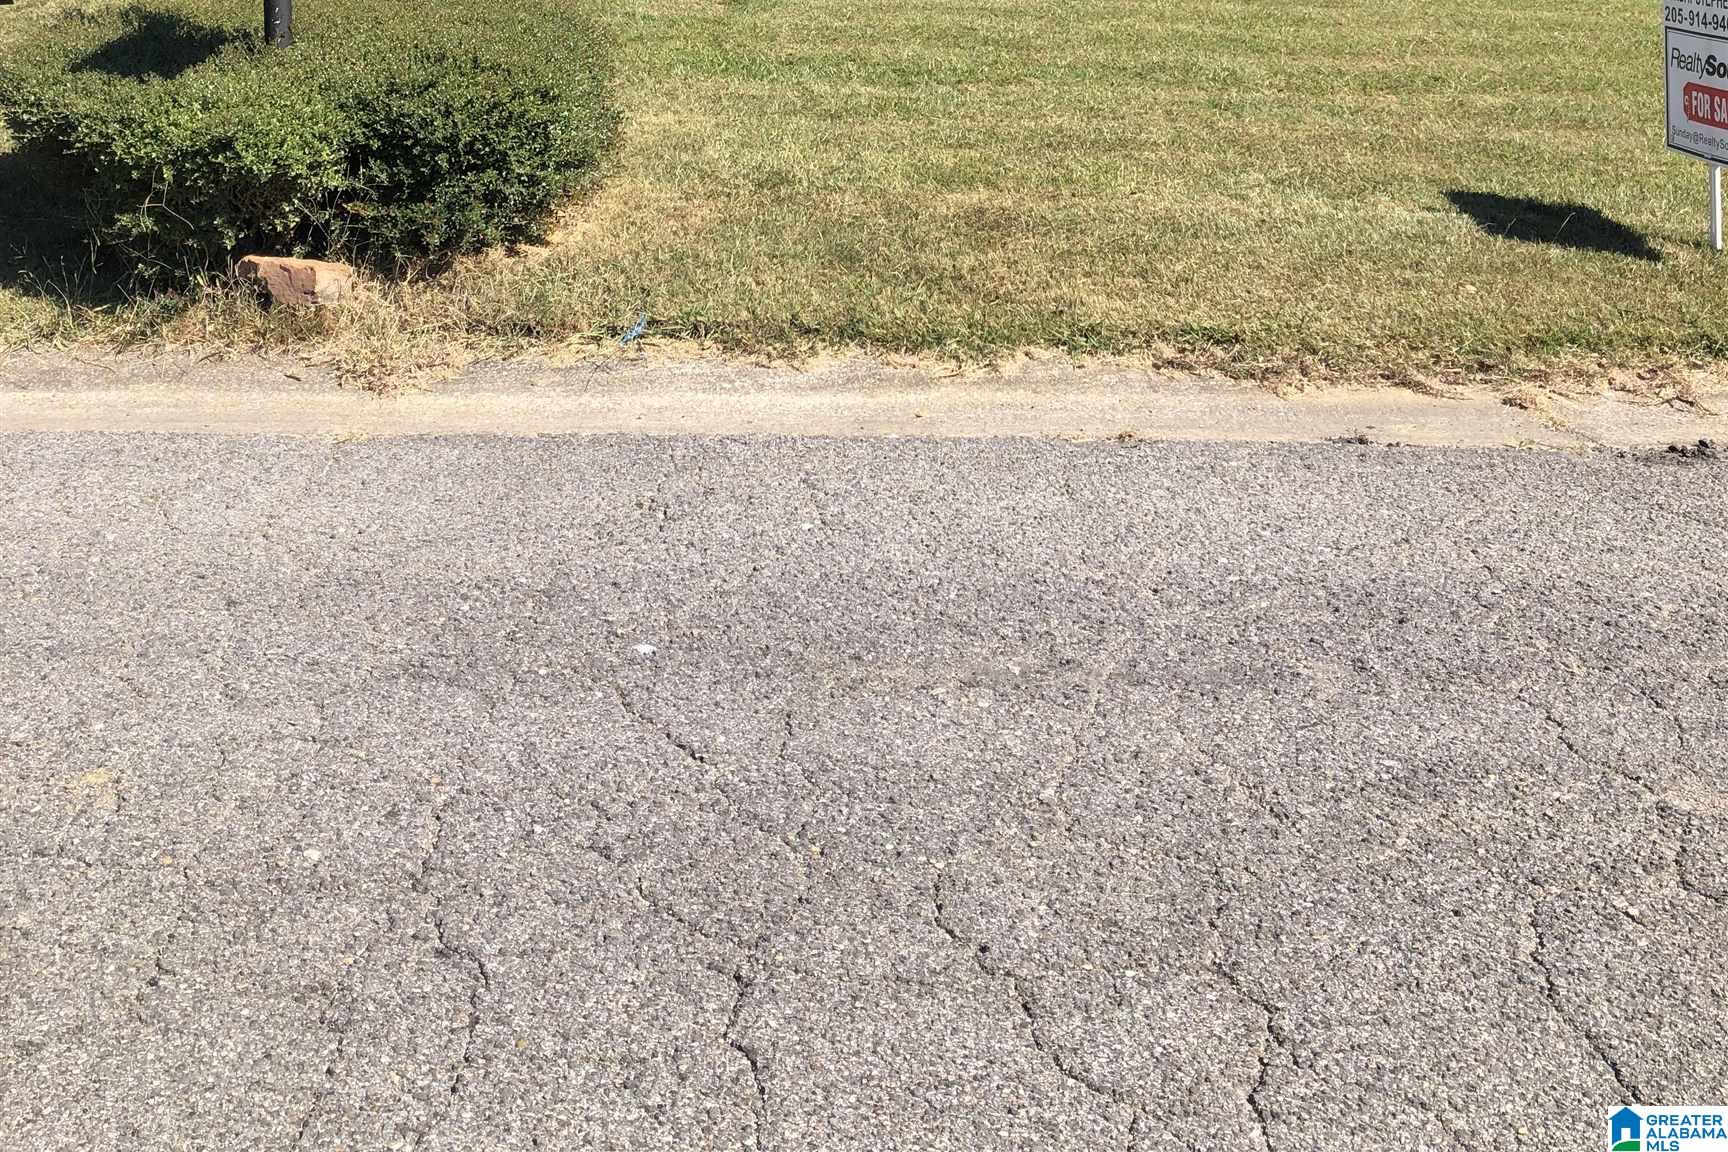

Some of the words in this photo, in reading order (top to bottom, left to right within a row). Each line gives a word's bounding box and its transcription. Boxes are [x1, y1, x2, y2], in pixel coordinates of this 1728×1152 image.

[1664, 6, 1728, 32] 205-914-94
[1671, 47, 1728, 80] RealtySo
[1691, 91, 1711, 120] FOR
[1714, 96, 1728, 124] SA
